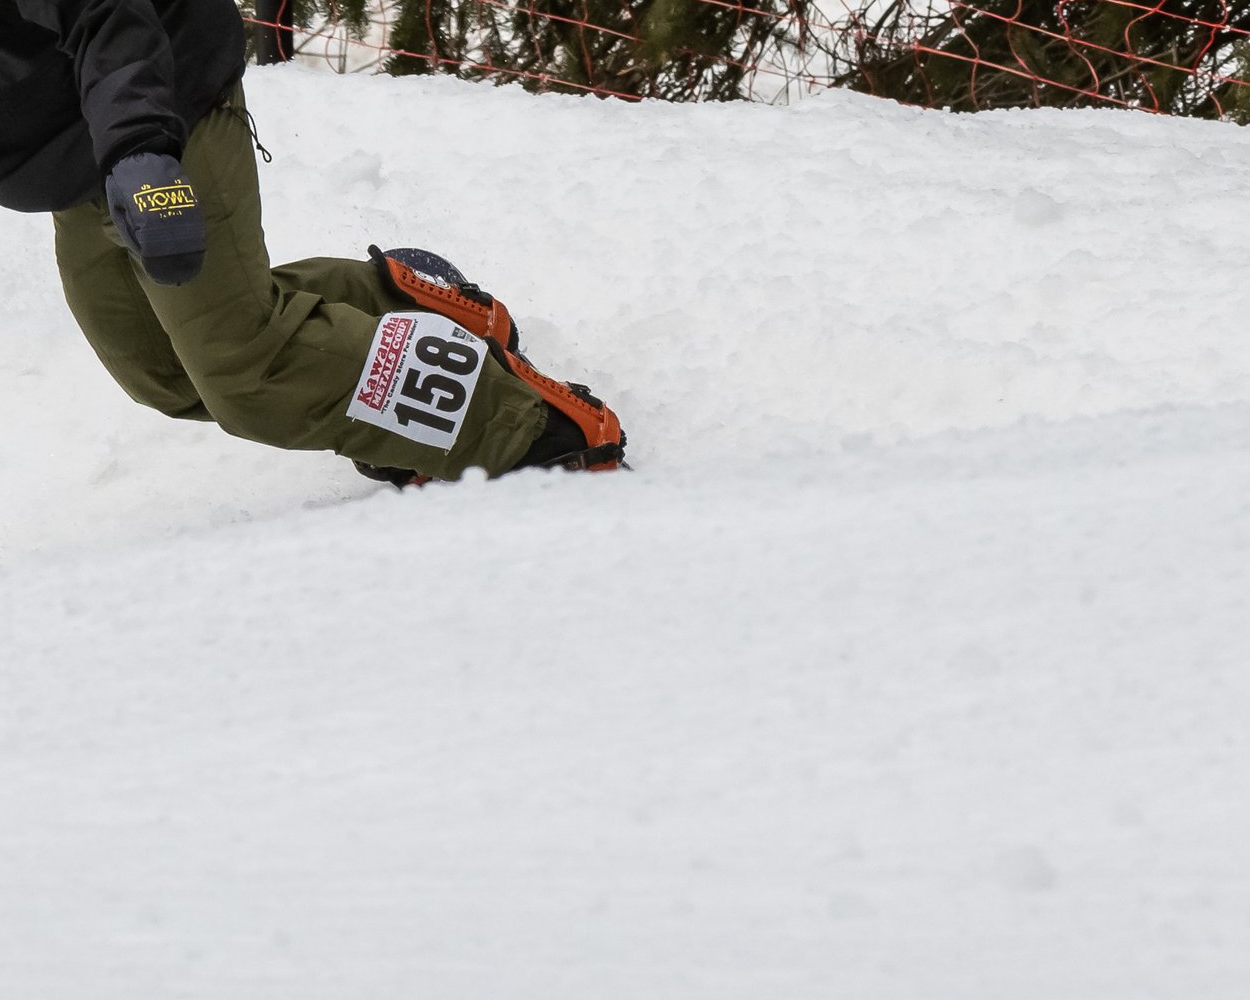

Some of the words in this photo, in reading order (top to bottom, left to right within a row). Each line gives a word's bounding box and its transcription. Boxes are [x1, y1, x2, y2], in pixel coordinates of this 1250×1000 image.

[137, 188, 194, 213] HOWL
[356, 316, 400, 407] Kawartha
[371, 351, 397, 407] METALS
[391, 320, 410, 351] CORP.
[393, 335, 480, 434] 158
